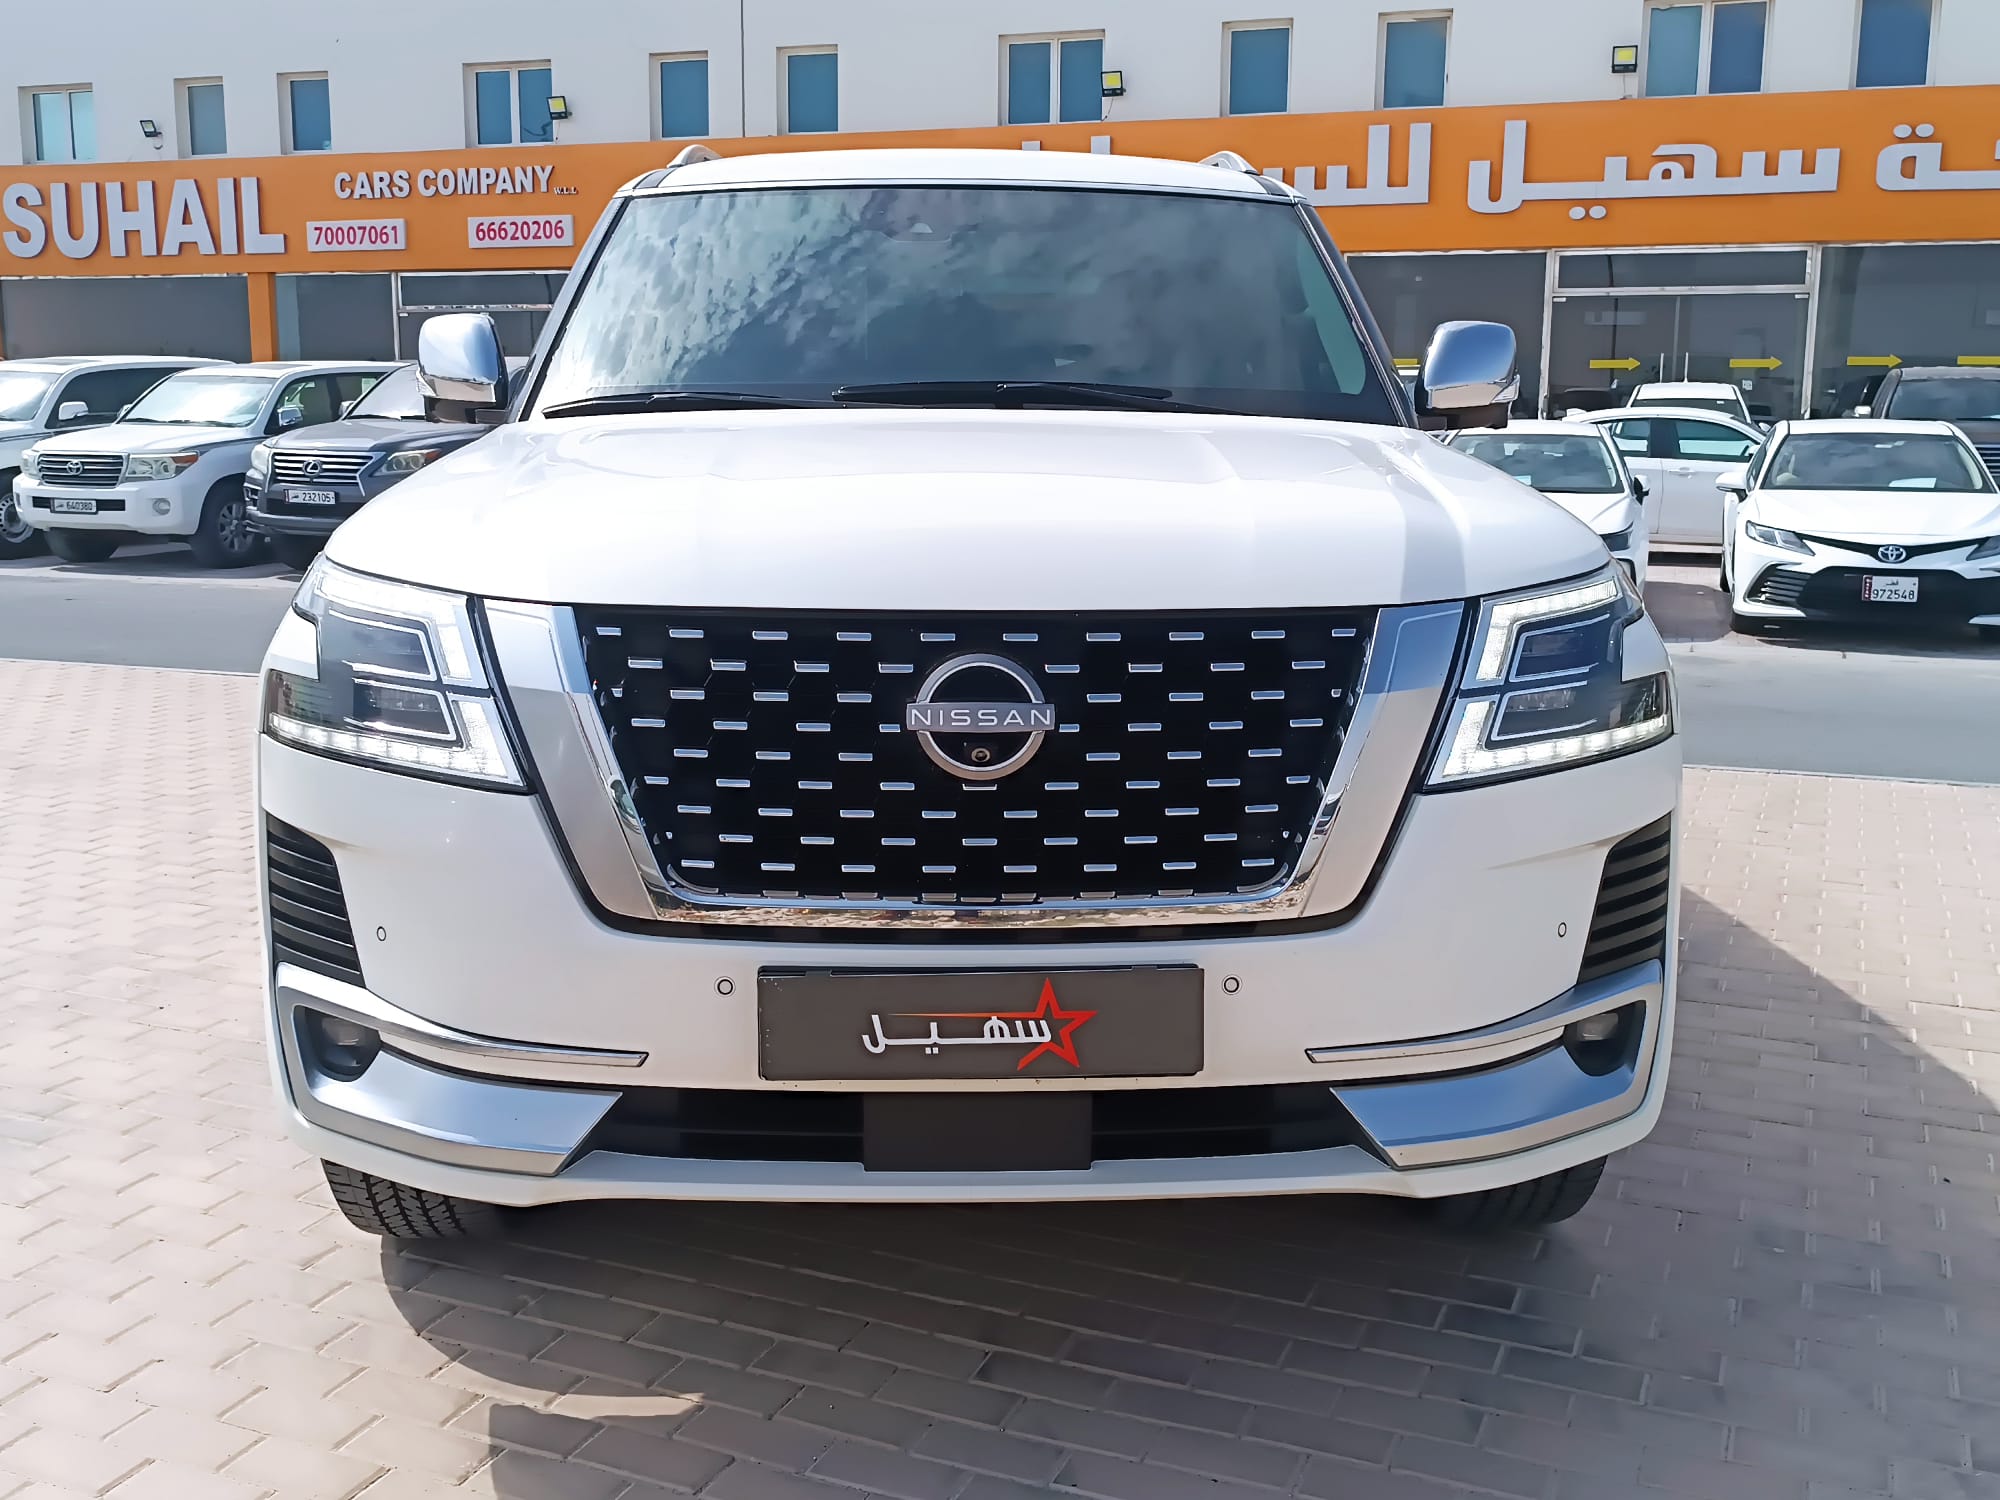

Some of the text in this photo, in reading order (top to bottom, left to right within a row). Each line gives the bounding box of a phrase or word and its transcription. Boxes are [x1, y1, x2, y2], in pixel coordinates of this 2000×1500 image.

[334, 170, 411, 200] CARS
[417, 165, 554, 197] COMPANY
[1467, 119, 1841, 220] سهيل
[2, 176, 286, 259] SUHAIL
[475, 220, 565, 242] 66620206
[313, 225, 399, 246] 70007061
[1872, 588, 1915, 600] 972548
[910, 707, 1053, 727] NISSAN
[861, 1012, 1052, 1055] سهيل
